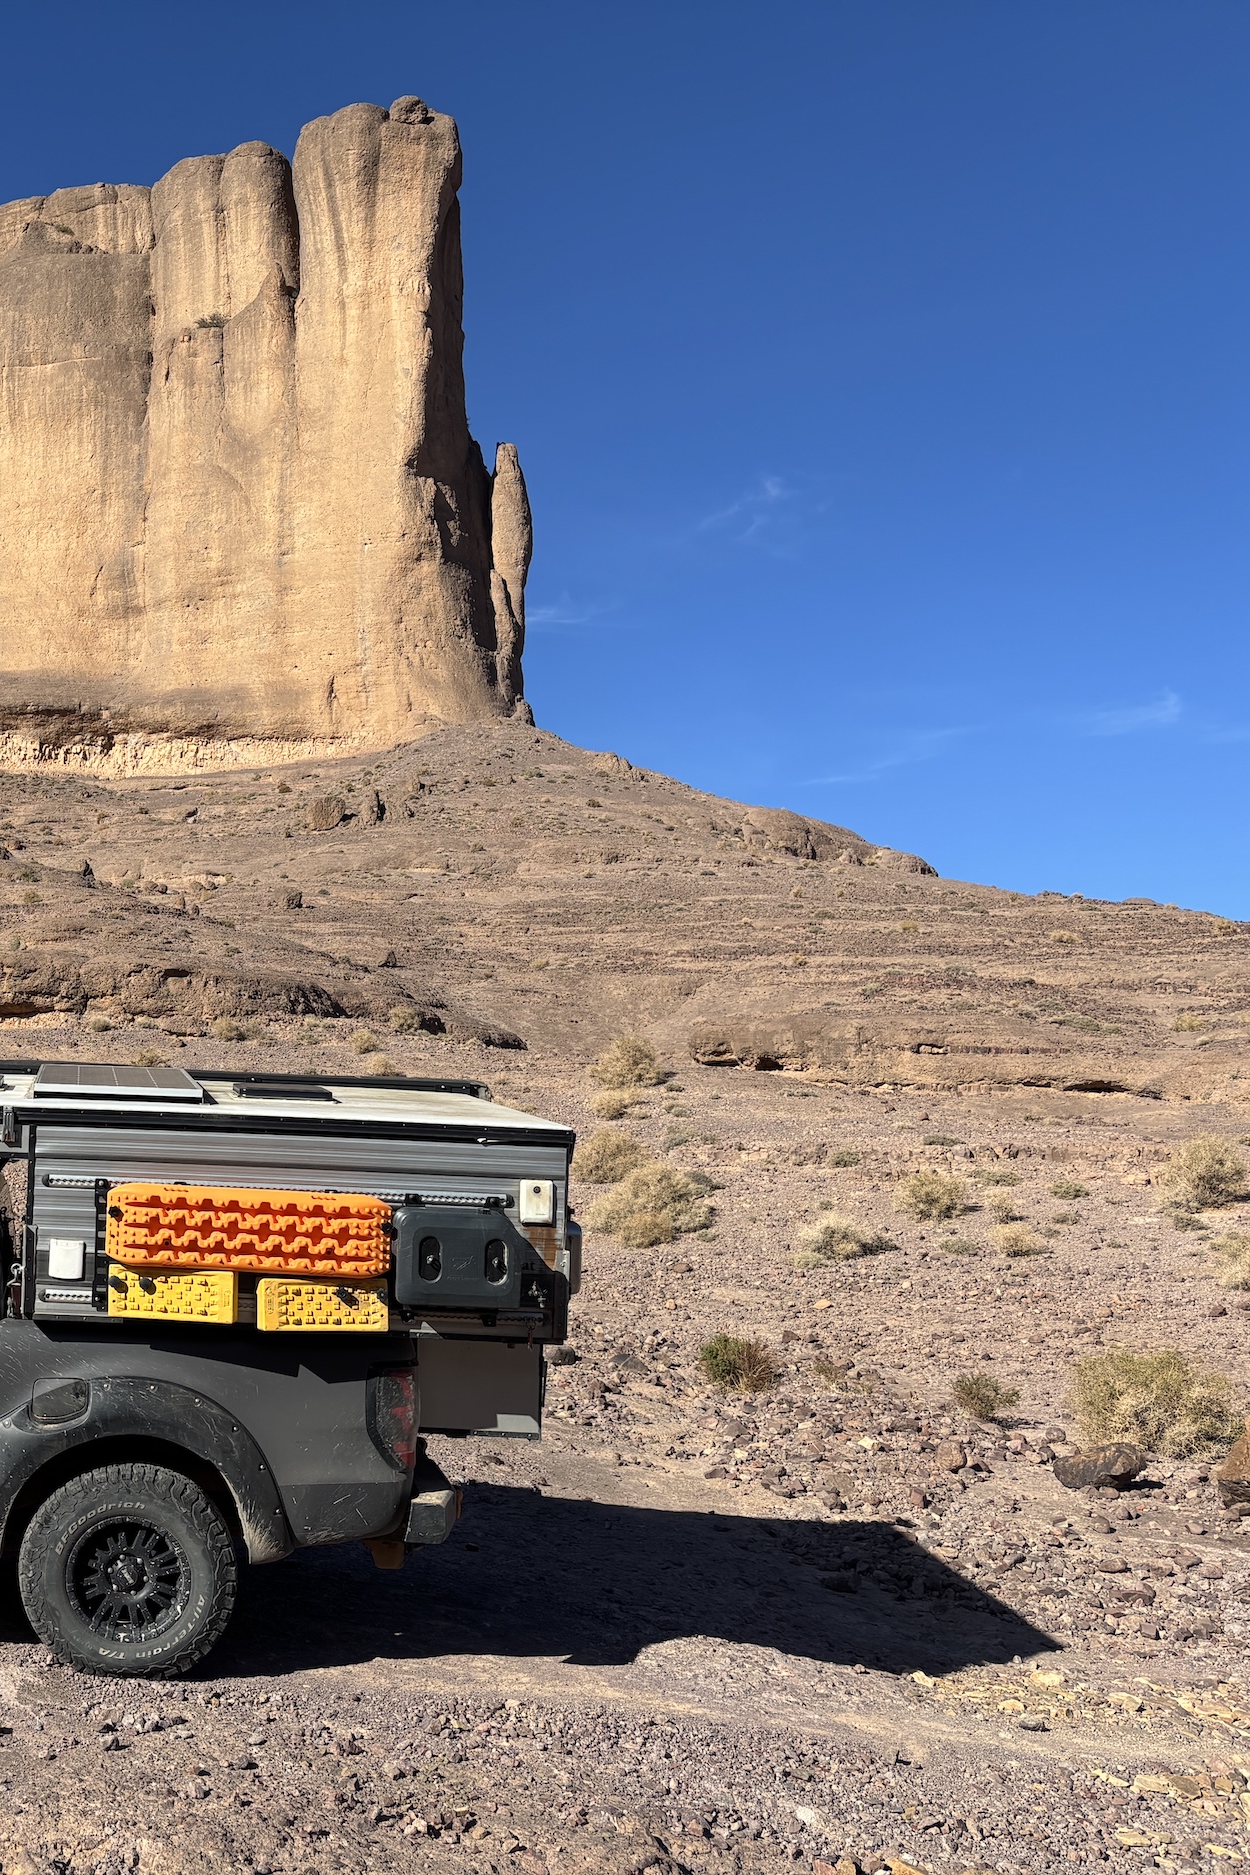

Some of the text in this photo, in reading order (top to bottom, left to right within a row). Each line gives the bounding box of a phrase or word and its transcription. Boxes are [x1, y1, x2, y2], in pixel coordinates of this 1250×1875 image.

[55, 1501, 146, 1556] BFGoodrich
[98, 1647, 126, 1660] T/A
[135, 1594, 206, 1658] All-Terrain
